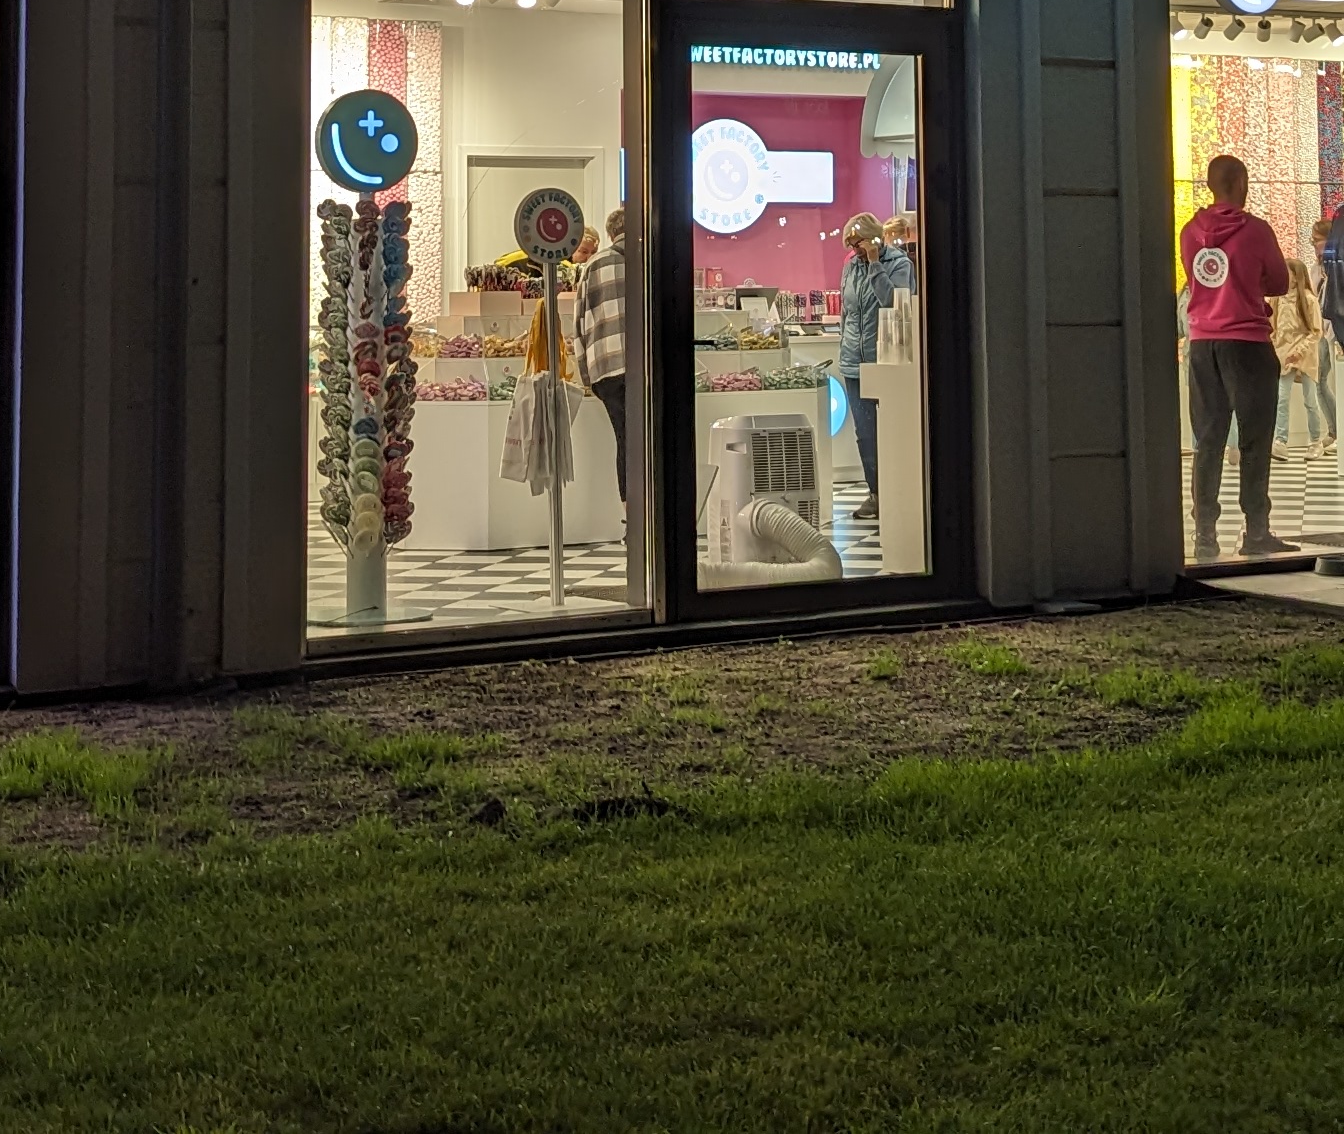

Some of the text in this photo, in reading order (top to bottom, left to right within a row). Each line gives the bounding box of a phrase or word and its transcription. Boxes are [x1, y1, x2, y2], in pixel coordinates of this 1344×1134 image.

[720, 126, 770, 171] FACTORY
[522, 192, 582, 224] SWEET FACTORY
[699, 208, 752, 226] STORE
[532, 245, 569, 260] STORE
